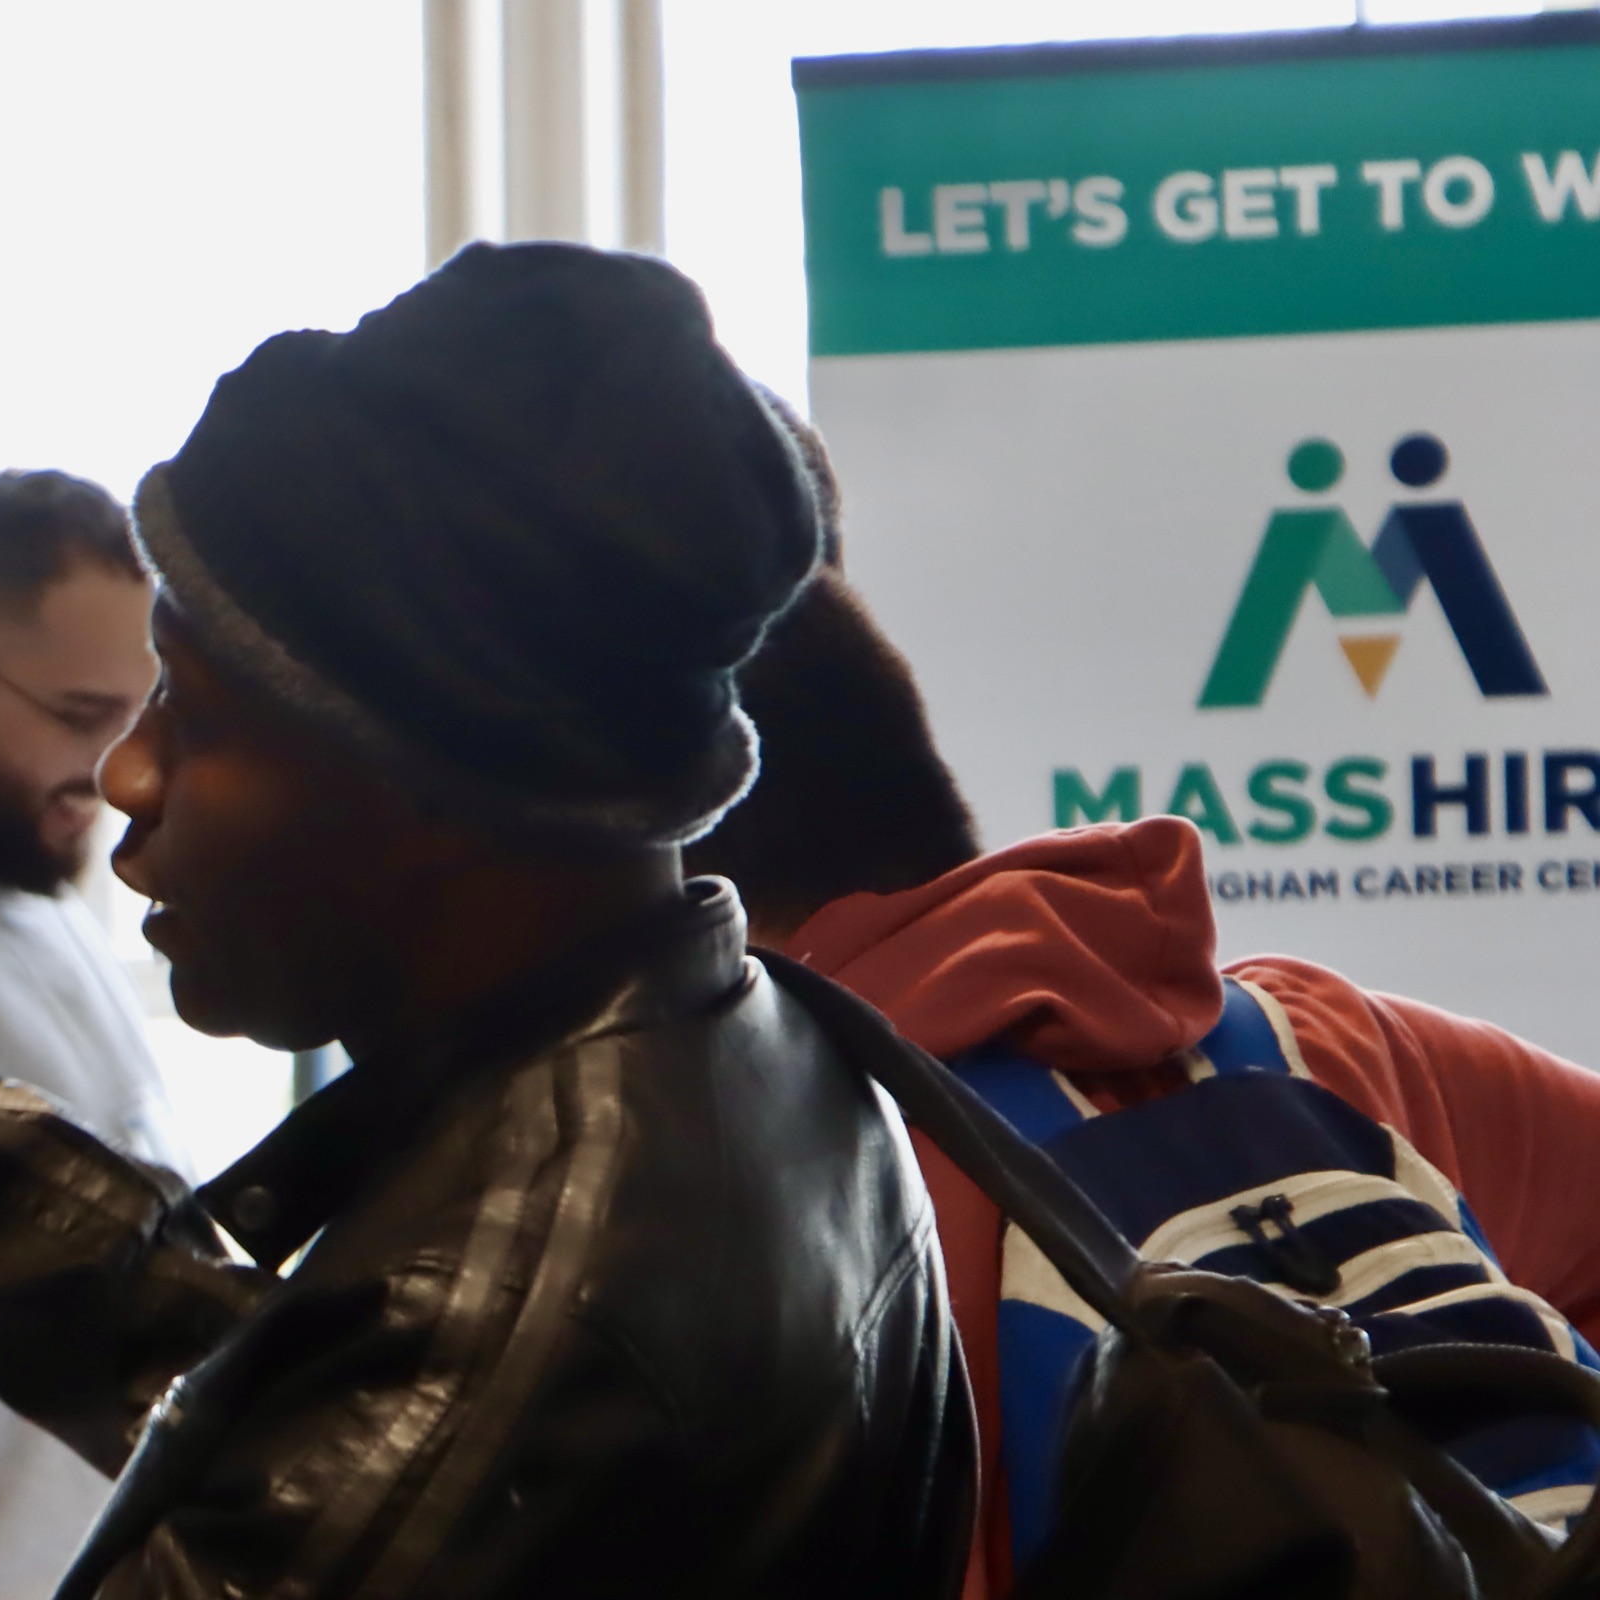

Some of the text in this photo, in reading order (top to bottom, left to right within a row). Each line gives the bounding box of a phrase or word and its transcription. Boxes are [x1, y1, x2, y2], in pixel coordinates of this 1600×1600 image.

[881, 175, 1128, 256] LET'S
[1153, 165, 1337, 242] GET
[1362, 155, 1495, 231] TO
[1208, 858, 1600, 900] GHAM CAREER CE
